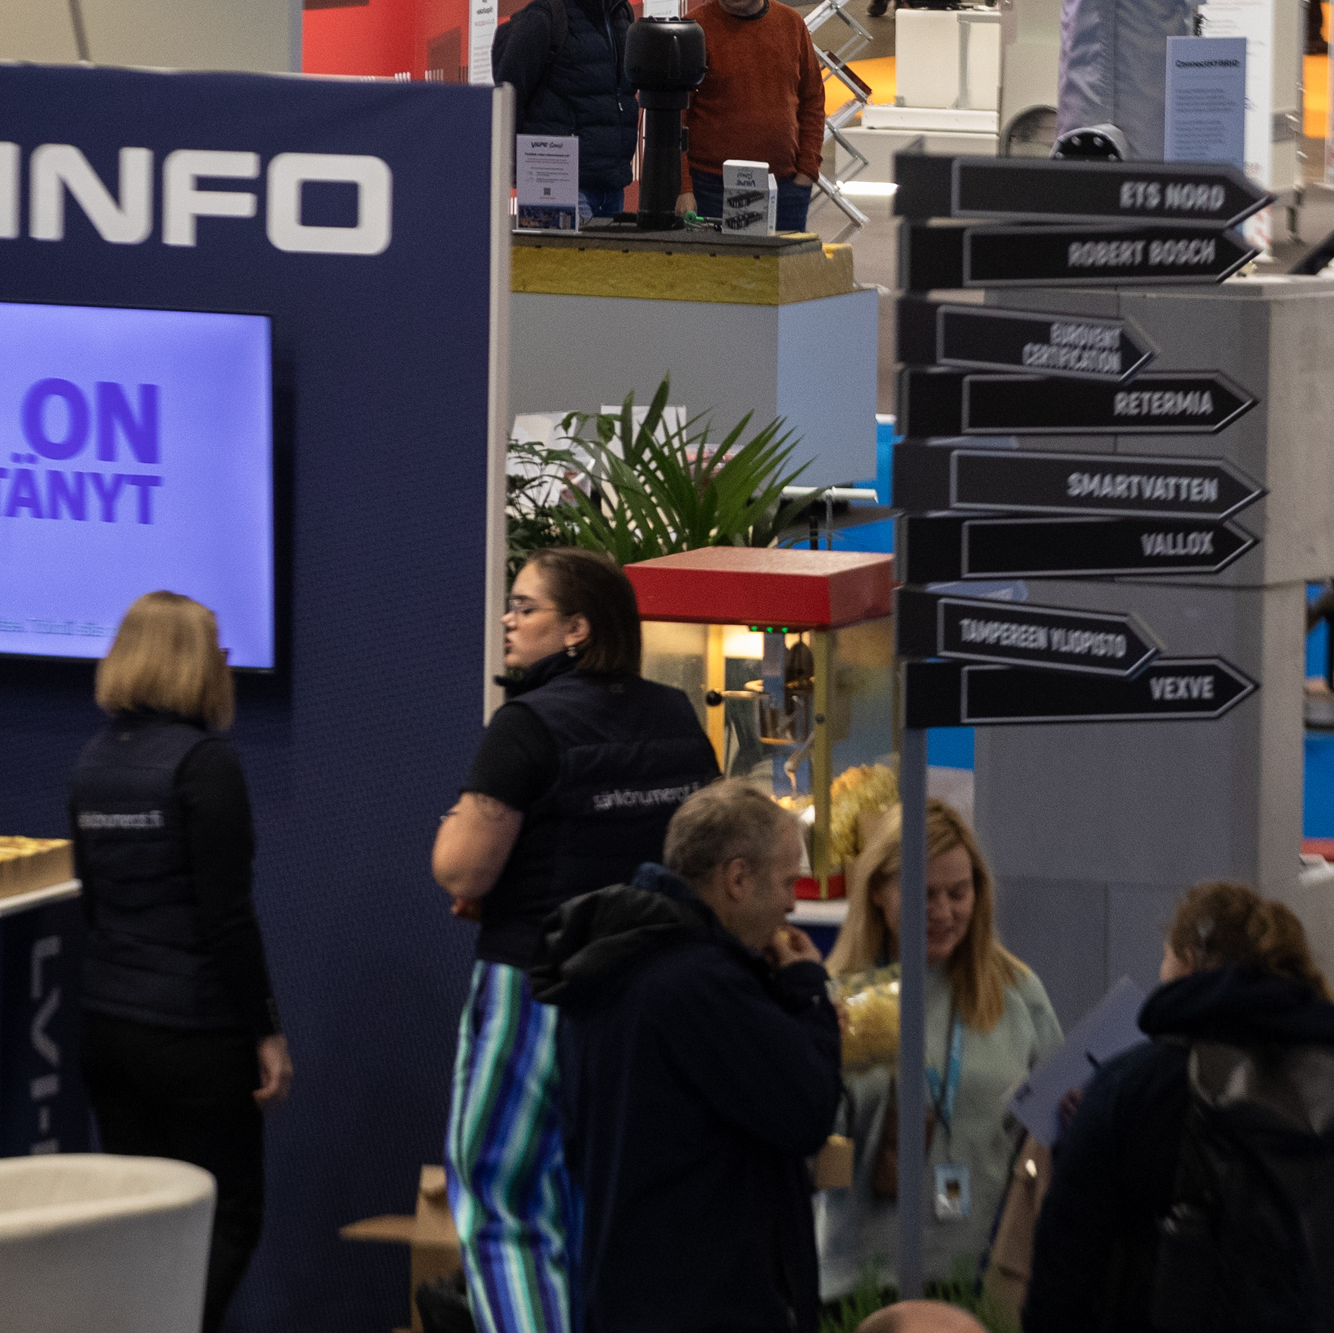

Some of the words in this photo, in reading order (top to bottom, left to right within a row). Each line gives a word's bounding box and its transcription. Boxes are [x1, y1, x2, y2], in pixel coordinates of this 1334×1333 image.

[1119, 181, 1161, 209] ETS
[1164, 182, 1226, 212] NORD
[1068, 239, 1147, 267] ROBERT
[1148, 237, 1216, 266] BOSCH
[1114, 390, 1214, 416] RETERMIA
[22, 376, 164, 465] ON
[1067, 461, 1219, 503] SMARTVATTEN
[1140, 530, 1215, 557] VALLOX
[959, 618, 1049, 651] TAMPEREEN
[1050, 627, 1128, 659] YLIOPISTO
[1149, 674, 1215, 701] VEXVE
